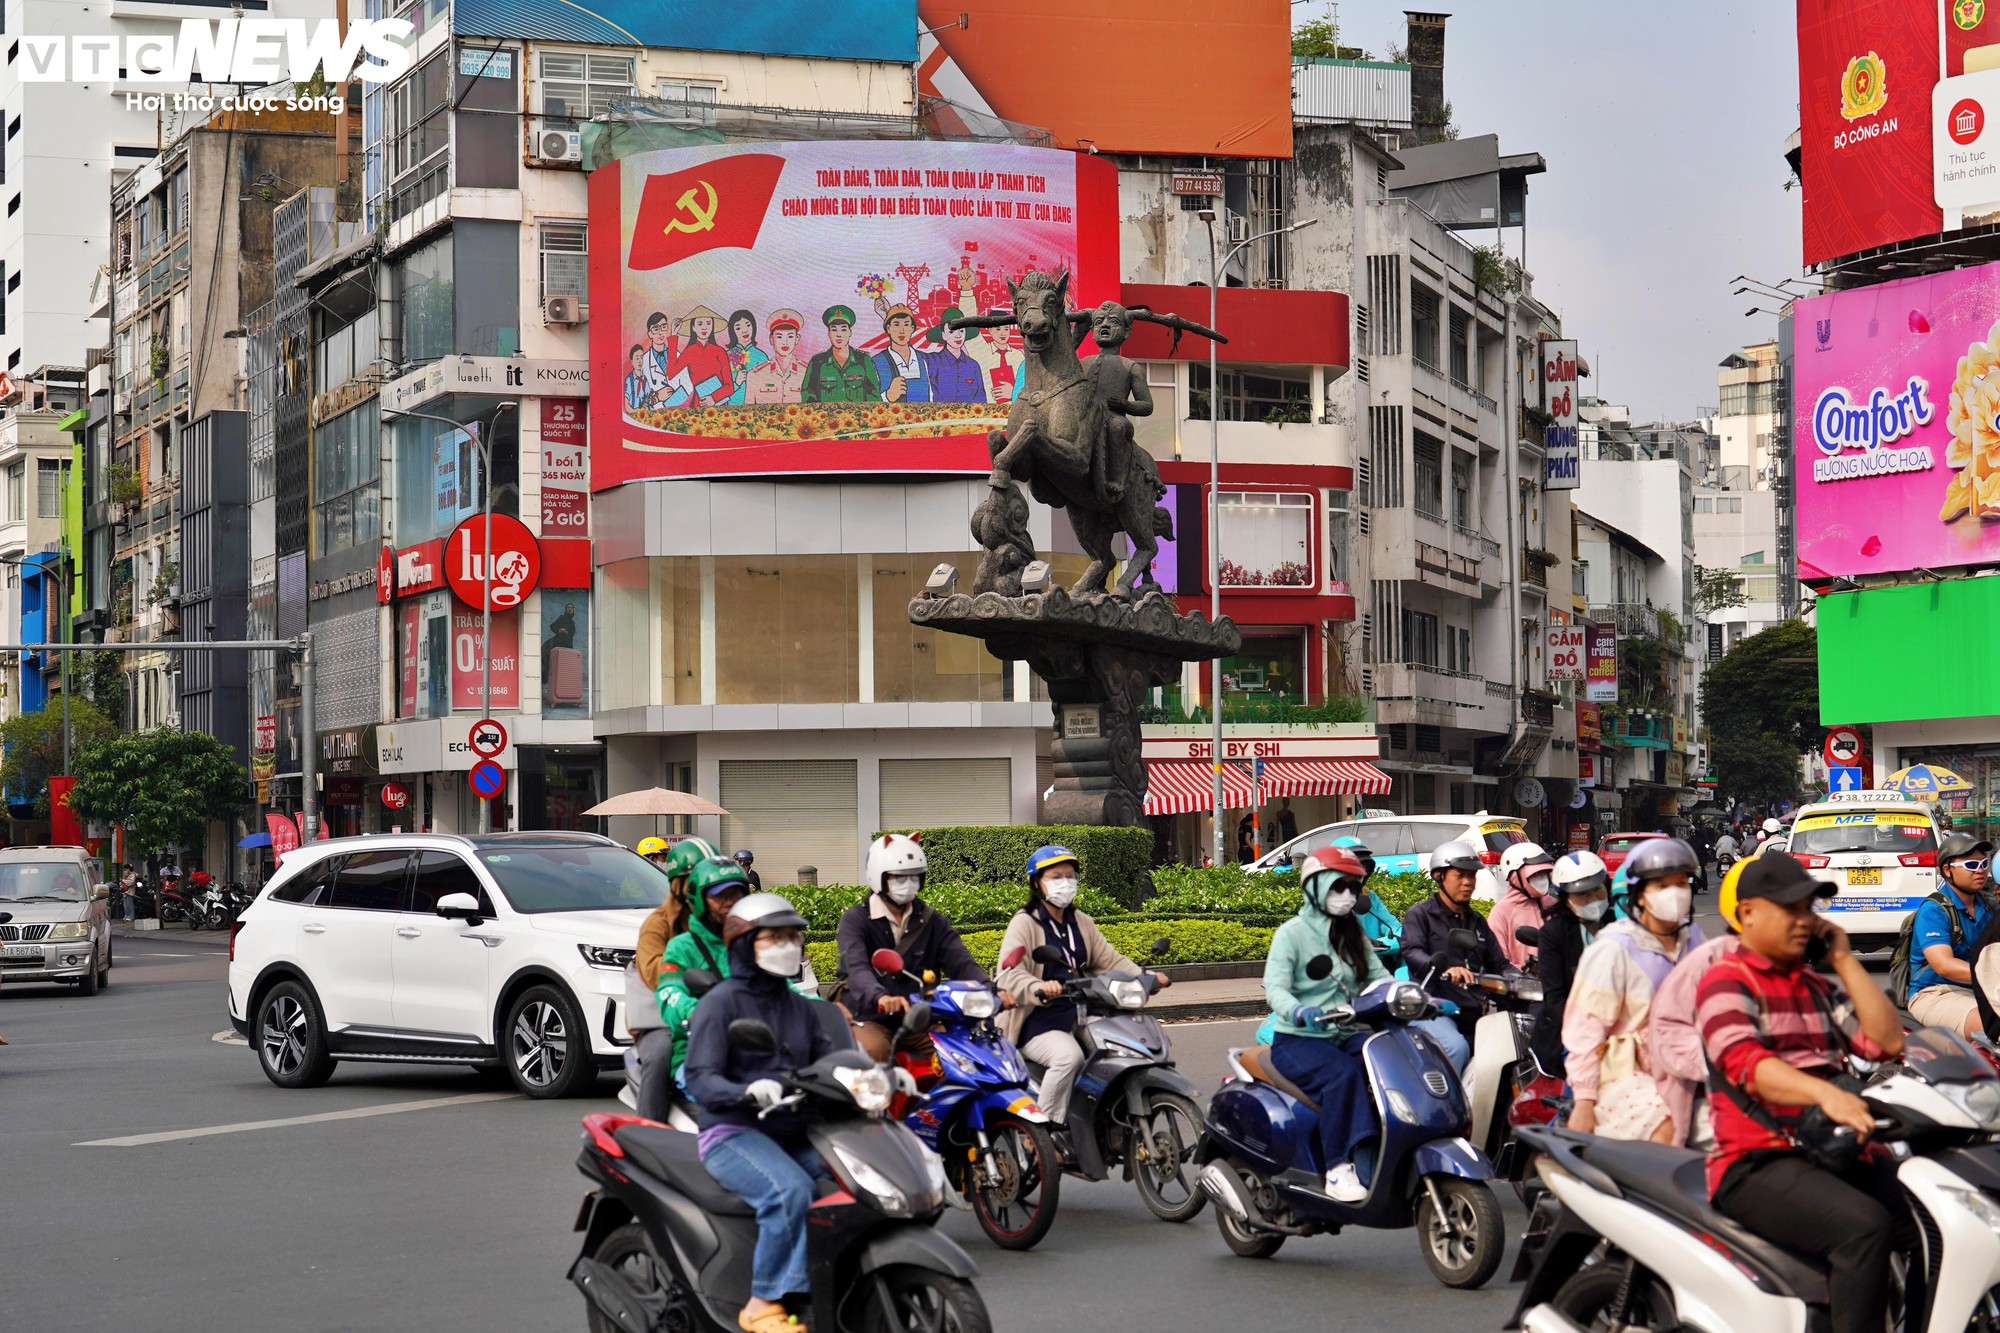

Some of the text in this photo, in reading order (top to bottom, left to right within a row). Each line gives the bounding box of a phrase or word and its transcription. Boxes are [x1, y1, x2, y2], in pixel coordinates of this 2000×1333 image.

[461, 62, 480, 75] 0935
[496, 65, 510, 78] 999
[1834, 117, 1898, 150] BỘ CÔNG AN
[1949, 150, 1986, 165] Thủ tục
[816, 165, 1046, 193] TOÀN ĐẢNG, TOÀN DÂN, TOÀN QUÂN LẬP THÀNH TÍCH
[1943, 164, 1996, 182] hành chính
[1175, 180, 1221, 192] 09 77 44 55 88
[782, 192, 1072, 224] CHÀO MỪNG ĐẠI HỘI ĐẠI BIỂU TOÀN QUỐC LẦN THỨ XIV CỦA ĐẢNG
[1546, 351, 1576, 382] CẦM
[1551, 386, 1572, 417] ĐỒ
[553, 405, 576, 421] 25
[1815, 381, 1928, 450] Comfort
[543, 422, 586, 431] THƯƠNG HIỆU
[563, 430, 572, 438] TẾ
[544, 451, 553, 467] 1
[574, 451, 583, 467] 1
[1547, 452, 1578, 479] PHÁT
[1815, 451, 1928, 478] HƯƠNG NƯỚC HOA
[542, 470, 586, 480] 365 NGÀY
[558, 499, 572, 508] TỐC
[560, 492, 580, 500] HÀNG
[543, 509, 586, 526] 2 GIỜ
[455, 613, 472, 628] TRẢ
[1548, 628, 1583, 647] CẦM
[1596, 637, 1615, 647] cafe
[492, 655, 515, 671] SUẤT
[1553, 648, 1578, 667] ĐỒ
[1599, 658, 1615, 668] egg
[1571, 668, 1584, 679] 3%
[1589, 667, 1615, 677] coffee
[492, 687, 508, 695] 6646
[323, 732, 358, 760] HUY THANH
[1227, 743, 1249, 757] BY
[1253, 742, 1280, 757] SHI
[1905, 776, 1930, 789] be
[1933, 774, 1959, 786] be
[387, 786, 406, 808] lug
[1834, 815, 1876, 825] MPE
